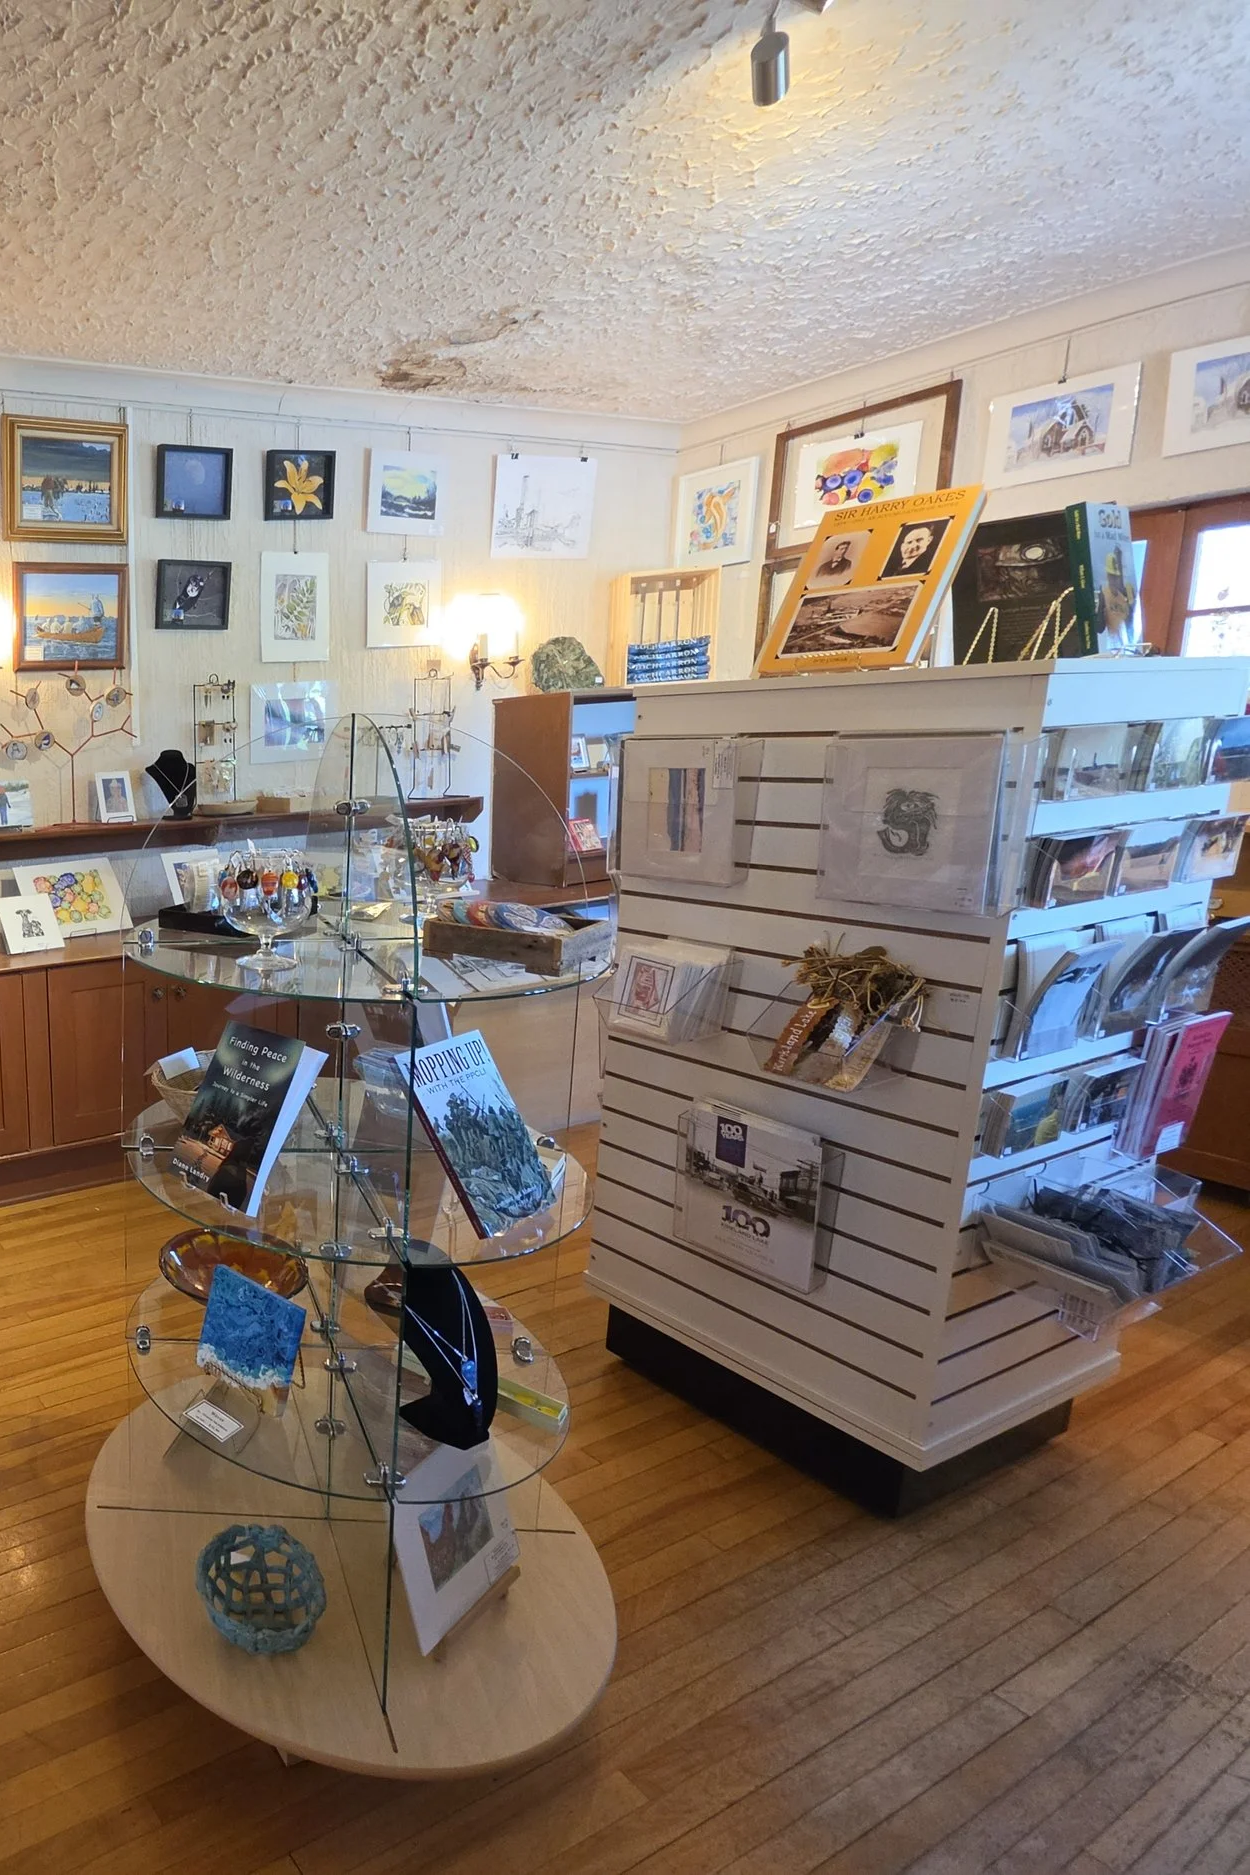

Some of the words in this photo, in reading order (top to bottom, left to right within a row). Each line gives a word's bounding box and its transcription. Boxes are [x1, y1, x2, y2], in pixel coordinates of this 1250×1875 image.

[834, 511, 857, 521] SIR
[861, 500, 909, 517] HARRY
[913, 490, 966, 506] OAKES
[1099, 509, 1122, 529] Gold
[229, 1036, 259, 1057] Finding
[261, 1046, 288, 1063] Peace
[773, 1023, 802, 1072] Kirkland
[799, 1010, 817, 1029] Lake
[250, 1061, 261, 1071] the
[403, 1046, 470, 1088] MOPPING
[464, 1039, 491, 1067] UP!
[223, 1065, 271, 1092] Wilderness
[426, 1082, 449, 1095] WITH
[449, 1076, 465, 1087] THE
[212, 1081, 228, 1093] Journey
[240, 1092, 257, 1103] Simpler
[258, 1098, 268, 1108] Life
[719, 1123, 743, 1136] 100
[721, 1130, 744, 1142] YEARS
[172, 1157, 190, 1172] Diane
[189, 1165, 210, 1183] Landry
[721, 1205, 771, 1238] 100
